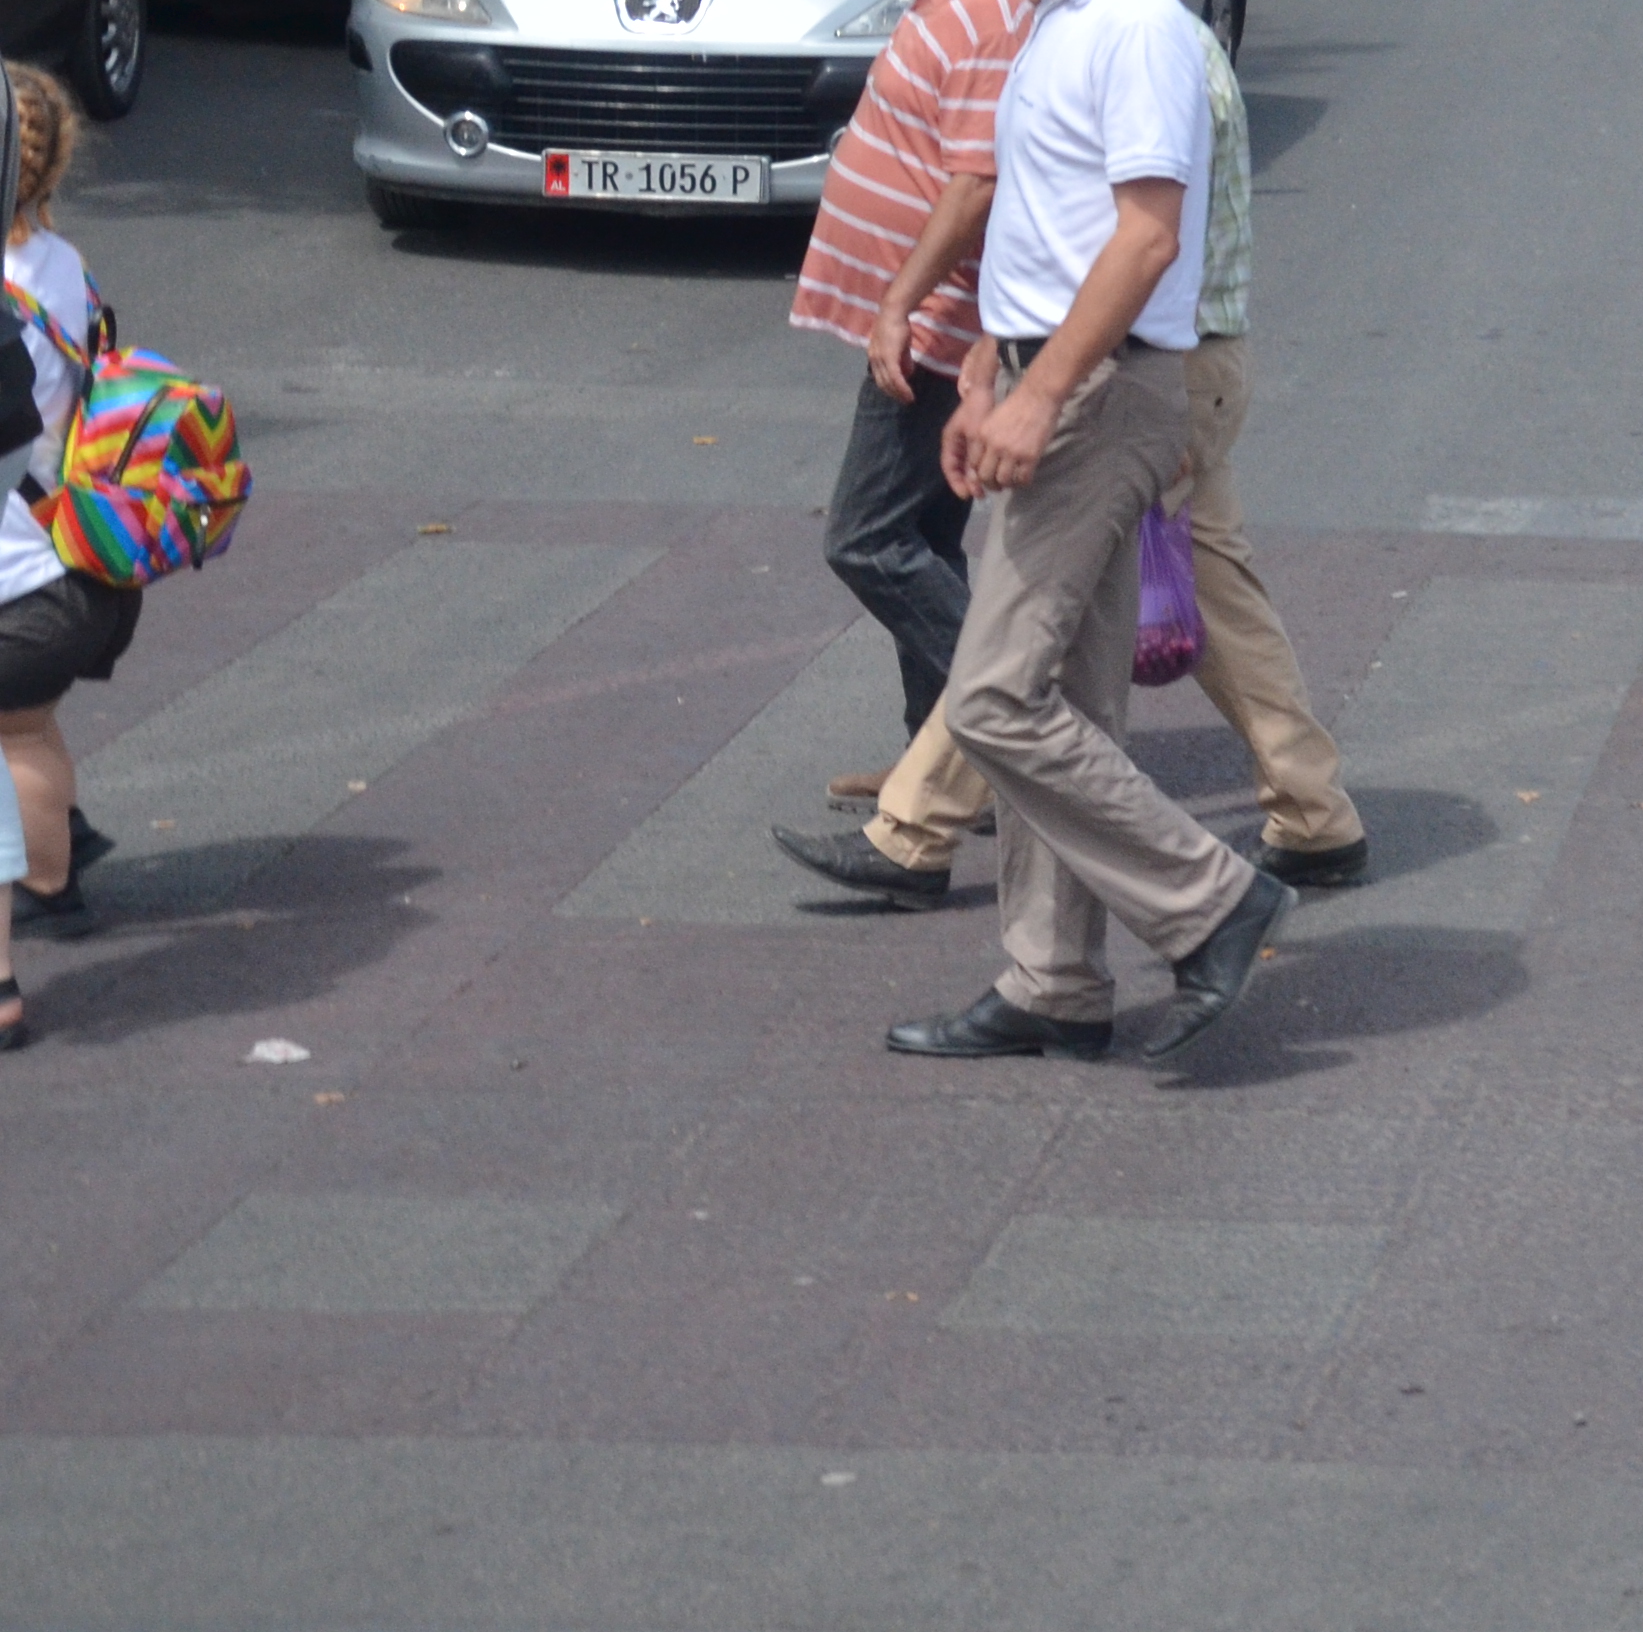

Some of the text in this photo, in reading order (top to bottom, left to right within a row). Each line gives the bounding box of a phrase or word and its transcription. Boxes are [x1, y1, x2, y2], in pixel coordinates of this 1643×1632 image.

[550, 160, 750, 196] AL TR 1056 P
